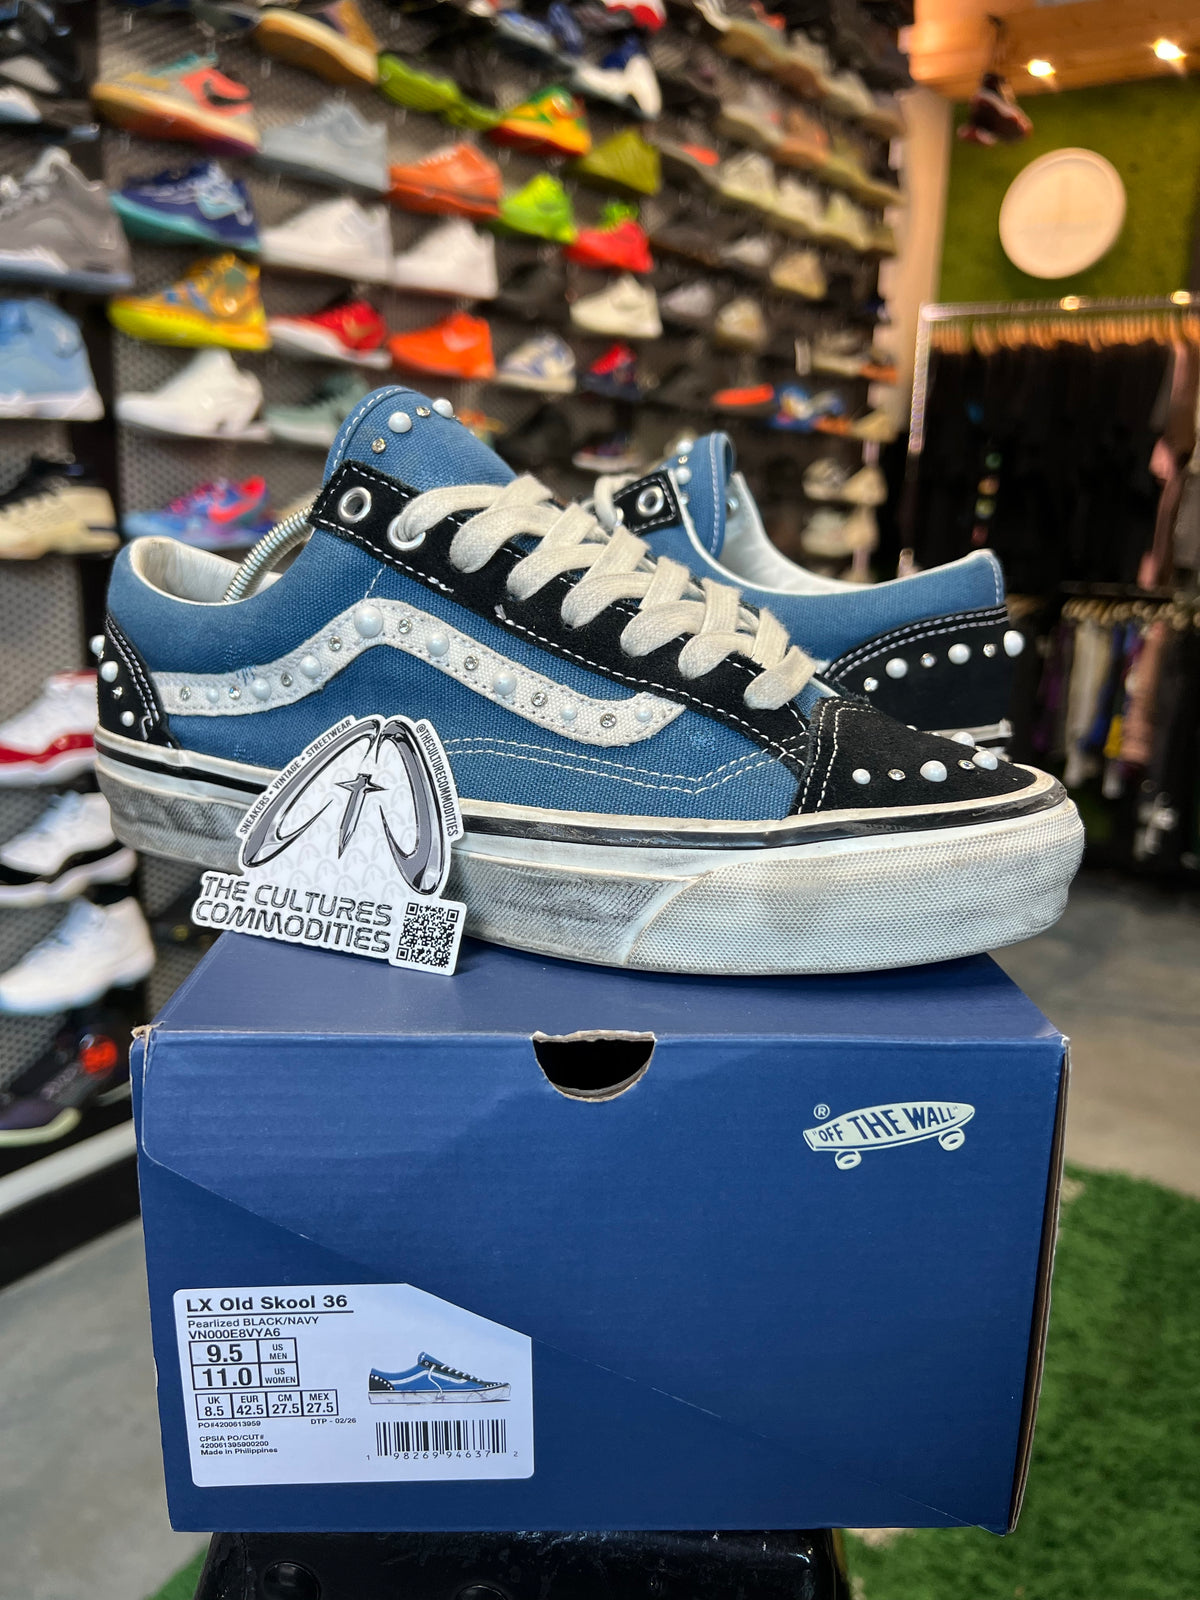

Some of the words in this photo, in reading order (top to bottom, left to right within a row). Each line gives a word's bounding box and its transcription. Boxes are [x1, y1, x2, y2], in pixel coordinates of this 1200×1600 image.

[240, 795, 271, 835] SNEAKERS
[272, 760, 302, 790] VINTAGE
[305, 719, 352, 757] STREETWEAR
[416, 723, 459, 837] @THECULTURECOMMODITIES
[204, 876, 250, 902] THE
[254, 884, 393, 927] CULTURES
[196, 900, 392, 954] COMMODITIES
[846, 1109, 906, 1140] THE
[186, 1298, 213, 1312] LX
[219, 1297, 253, 1311] Old
[260, 1295, 316, 1310] Skool
[322, 1294, 348, 1308] 36
[188, 1319, 240, 1329] Pearlized
[243, 1316, 319, 1327] BLACK/NAVY
[188, 1327, 281, 1340] VN000E8VYA6
[272, 1343, 284, 1351] US
[206, 1343, 243, 1363] 9.5
[269, 1352, 288, 1360] MEN
[274, 1367, 286, 1375] US
[202, 1367, 252, 1387] 11.0
[265, 1376, 296, 1384] WOMEN
[207, 1396, 220, 1404] UK
[240, 1395, 259, 1403] EUR
[277, 1393, 293, 1402] CM
[309, 1392, 330, 1401] MEX
[204, 1406, 224, 1417] 8.5
[236, 1404, 264, 1415] 42.5
[271, 1403, 300, 1414] 27.5
[305, 1402, 334, 1413] 27.5
[227, 1433, 265, 1441] PO/CUT#
[234, 1447, 278, 1455] Philippines
